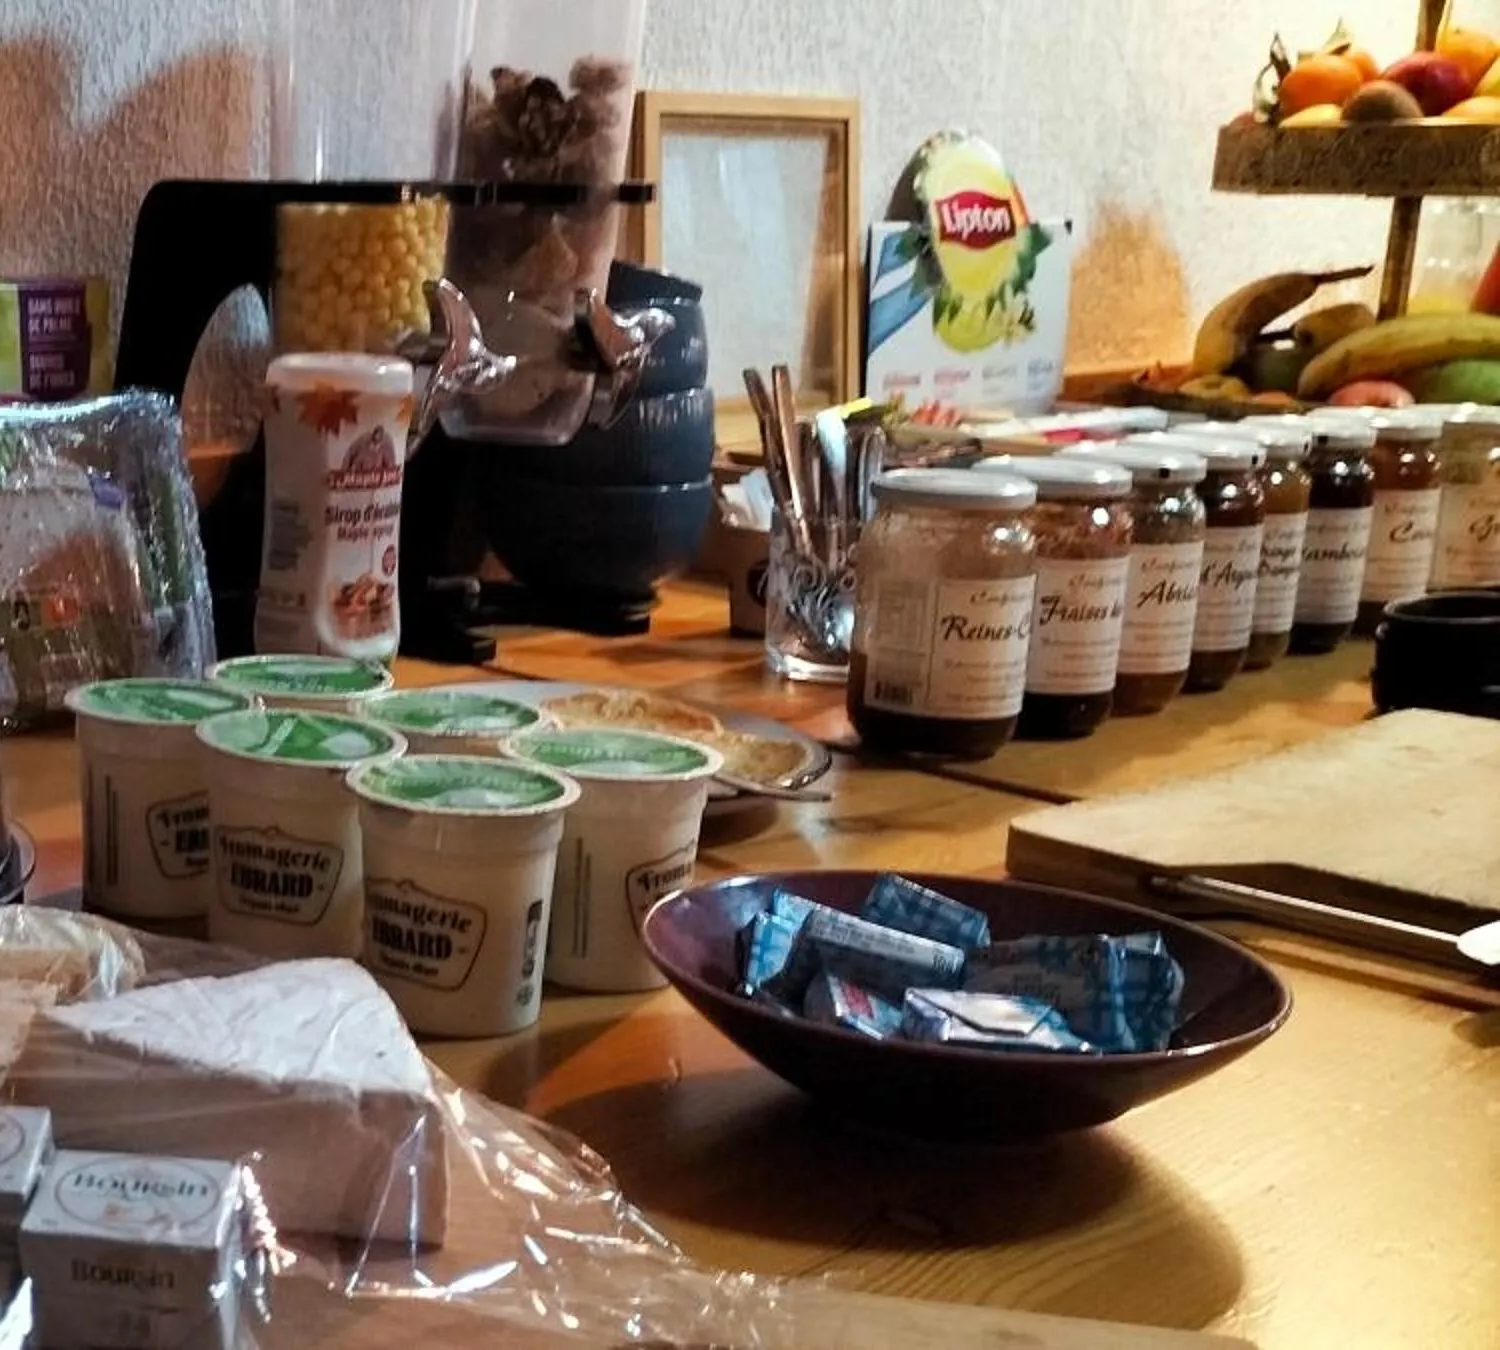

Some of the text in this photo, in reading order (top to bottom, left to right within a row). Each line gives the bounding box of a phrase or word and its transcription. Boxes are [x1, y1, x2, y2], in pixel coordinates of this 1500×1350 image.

[939, 199, 1011, 240] Lipton
[1039, 595, 1109, 627] Fraises
[219, 836, 333, 873] Fromagerie
[231, 861, 313, 898] EBRARD
[74, 1173, 208, 1200] Boursin
[70, 1258, 176, 1293] Boursin
